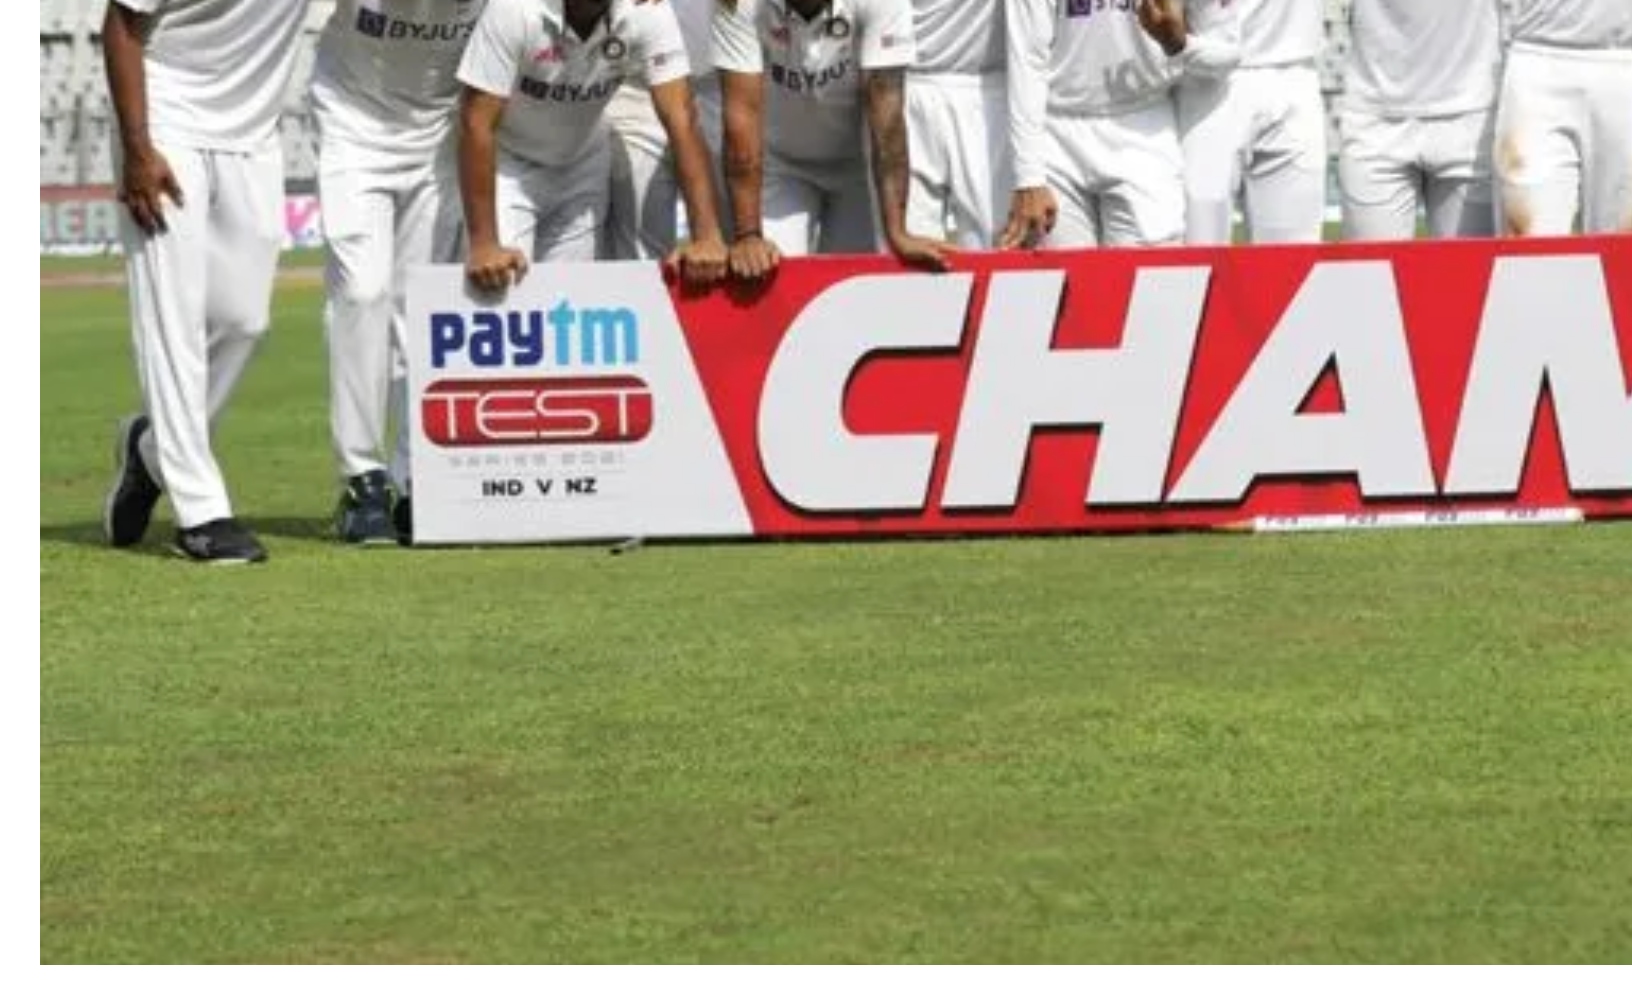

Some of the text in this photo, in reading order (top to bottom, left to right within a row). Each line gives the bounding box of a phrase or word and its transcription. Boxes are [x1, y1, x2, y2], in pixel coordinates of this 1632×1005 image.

[423, 387, 653, 440] TEST
[482, 477, 598, 497] IND V NZ
